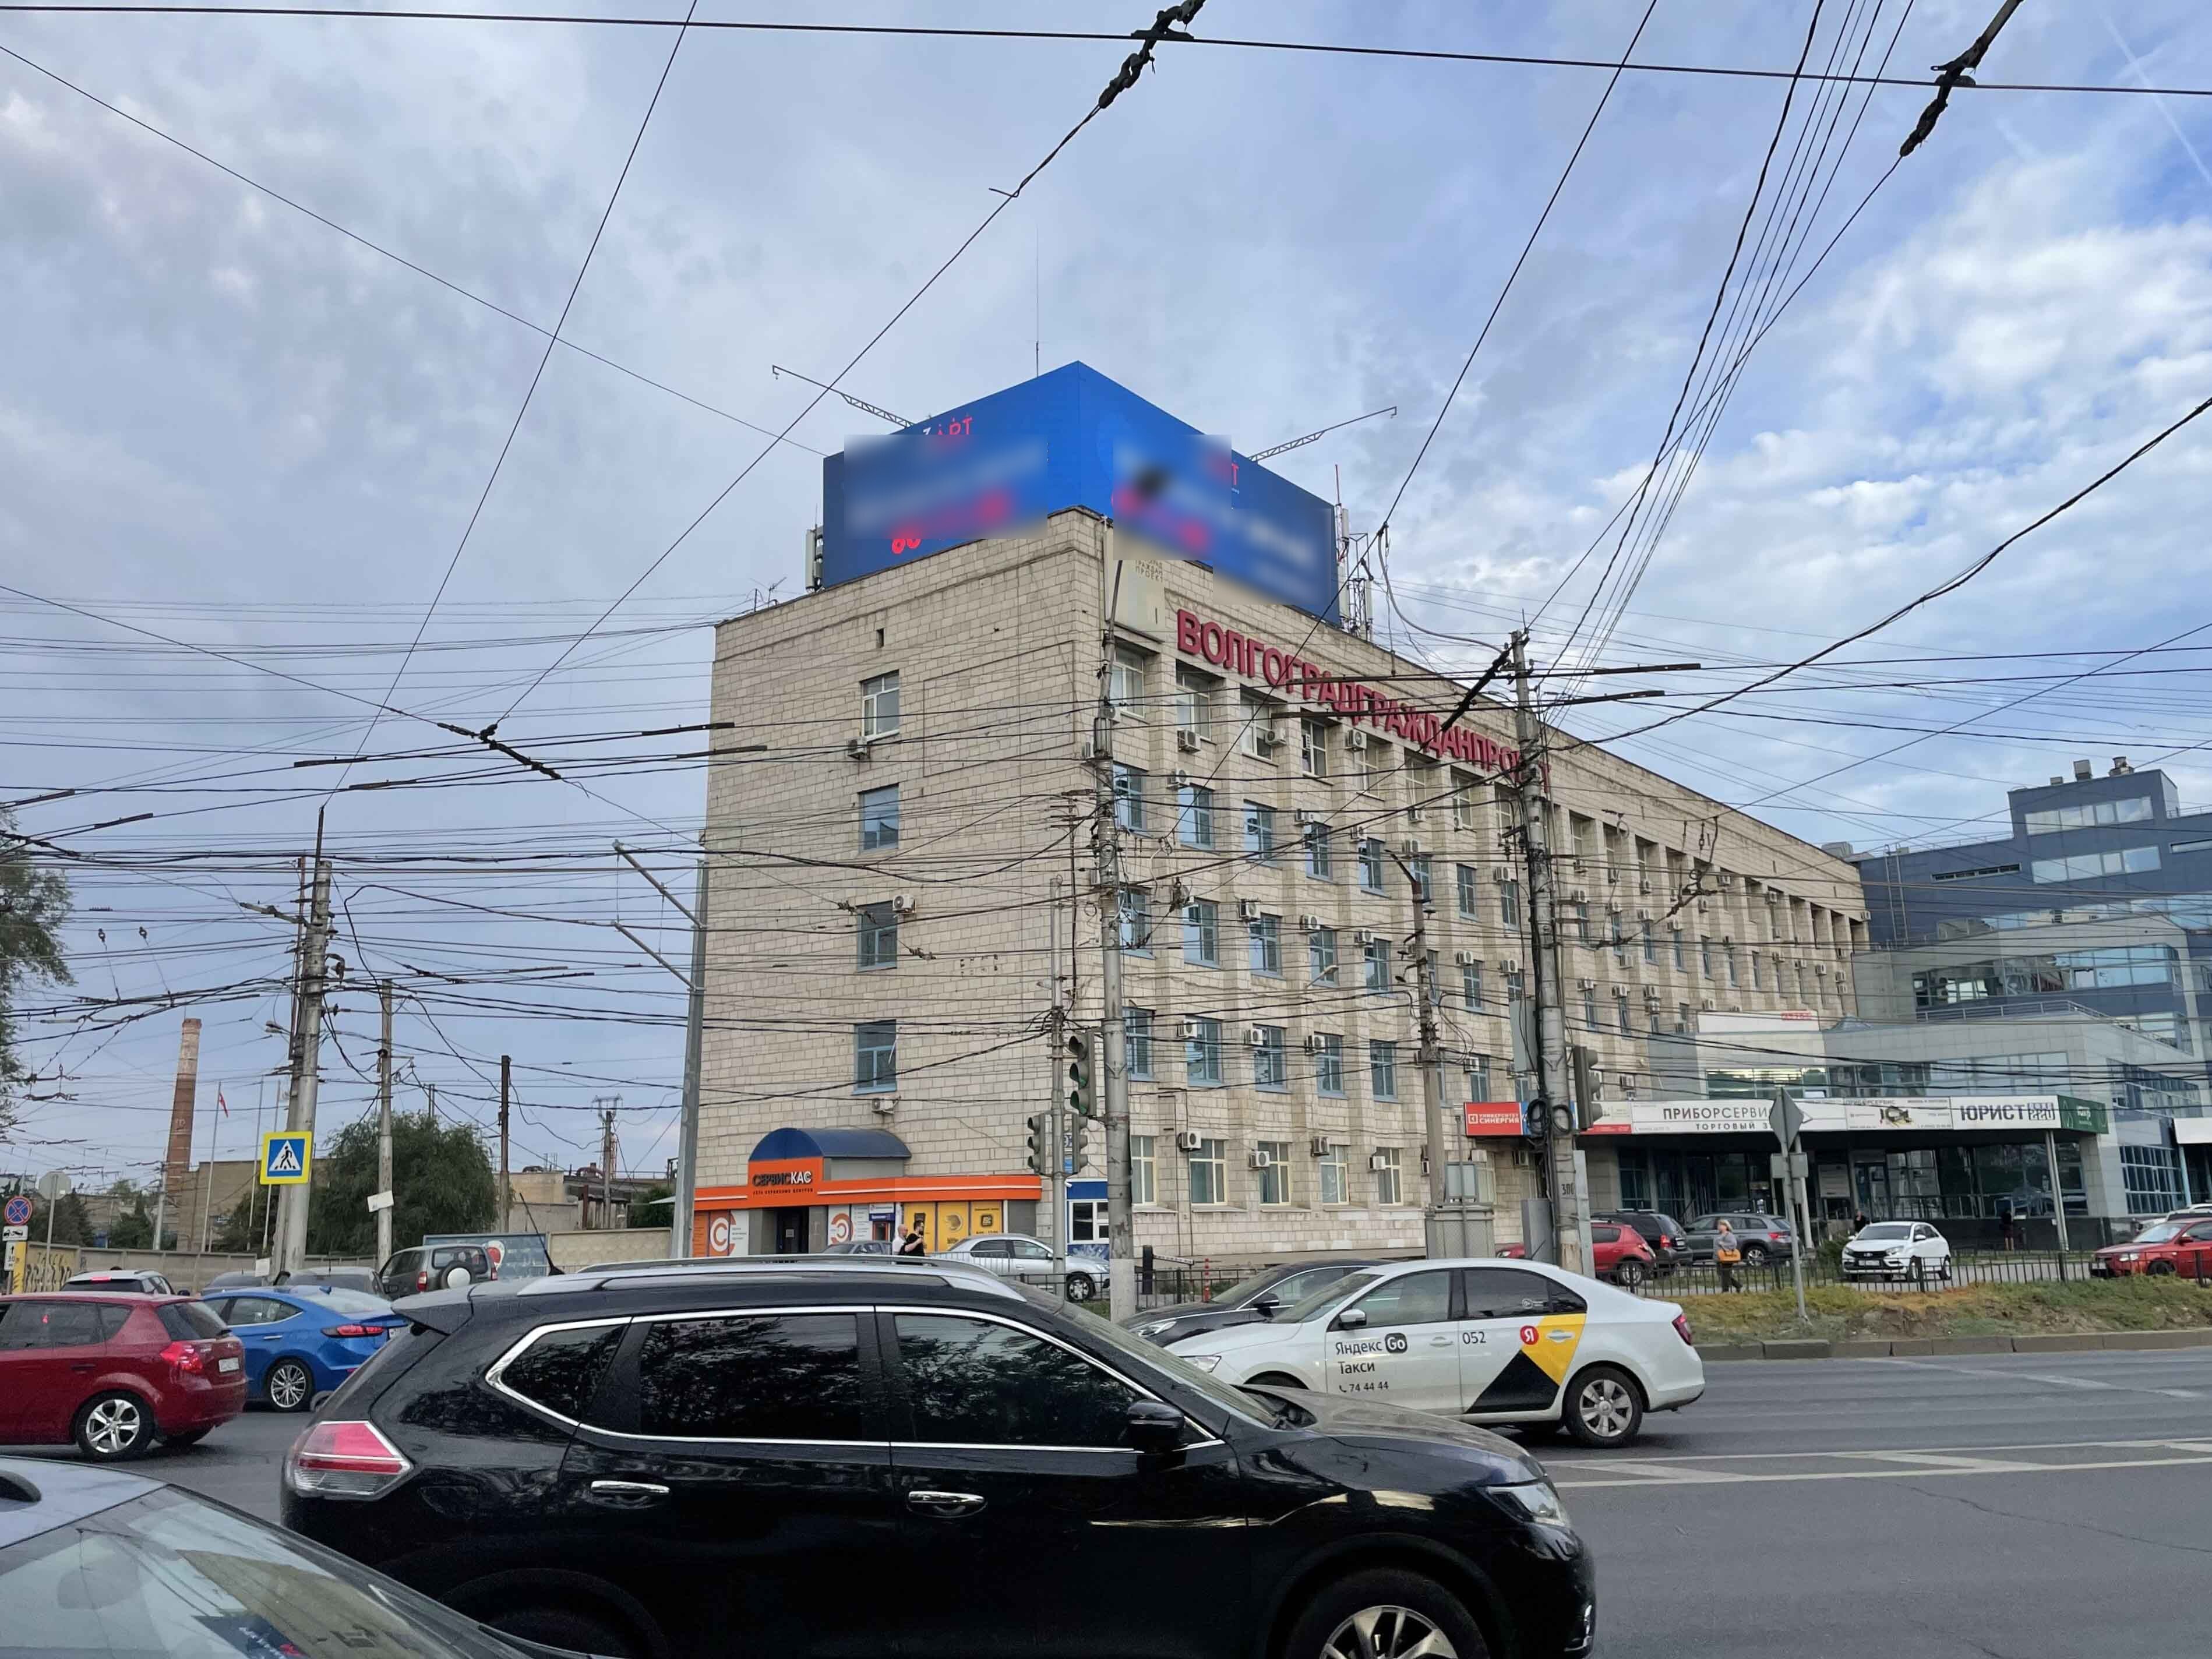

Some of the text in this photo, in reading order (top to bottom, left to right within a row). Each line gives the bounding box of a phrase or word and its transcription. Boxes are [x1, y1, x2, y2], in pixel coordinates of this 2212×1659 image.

[1663, 1107, 1770, 1120] ПРИБОРСЕРВИ
[1960, 1104, 2026, 1121] ЮРИСТ
[1696, 1122, 1755, 1130] ТОРГОВЫЙ
[1462, 1331, 1486, 1344] 052
[1524, 1328, 1534, 1342] Я
[1335, 1342, 1383, 1355] Яндекс
[1387, 1337, 1405, 1350] Go
[1337, 1361, 1375, 1374] Такси
[1349, 1381, 1389, 1392] 74 44 44
